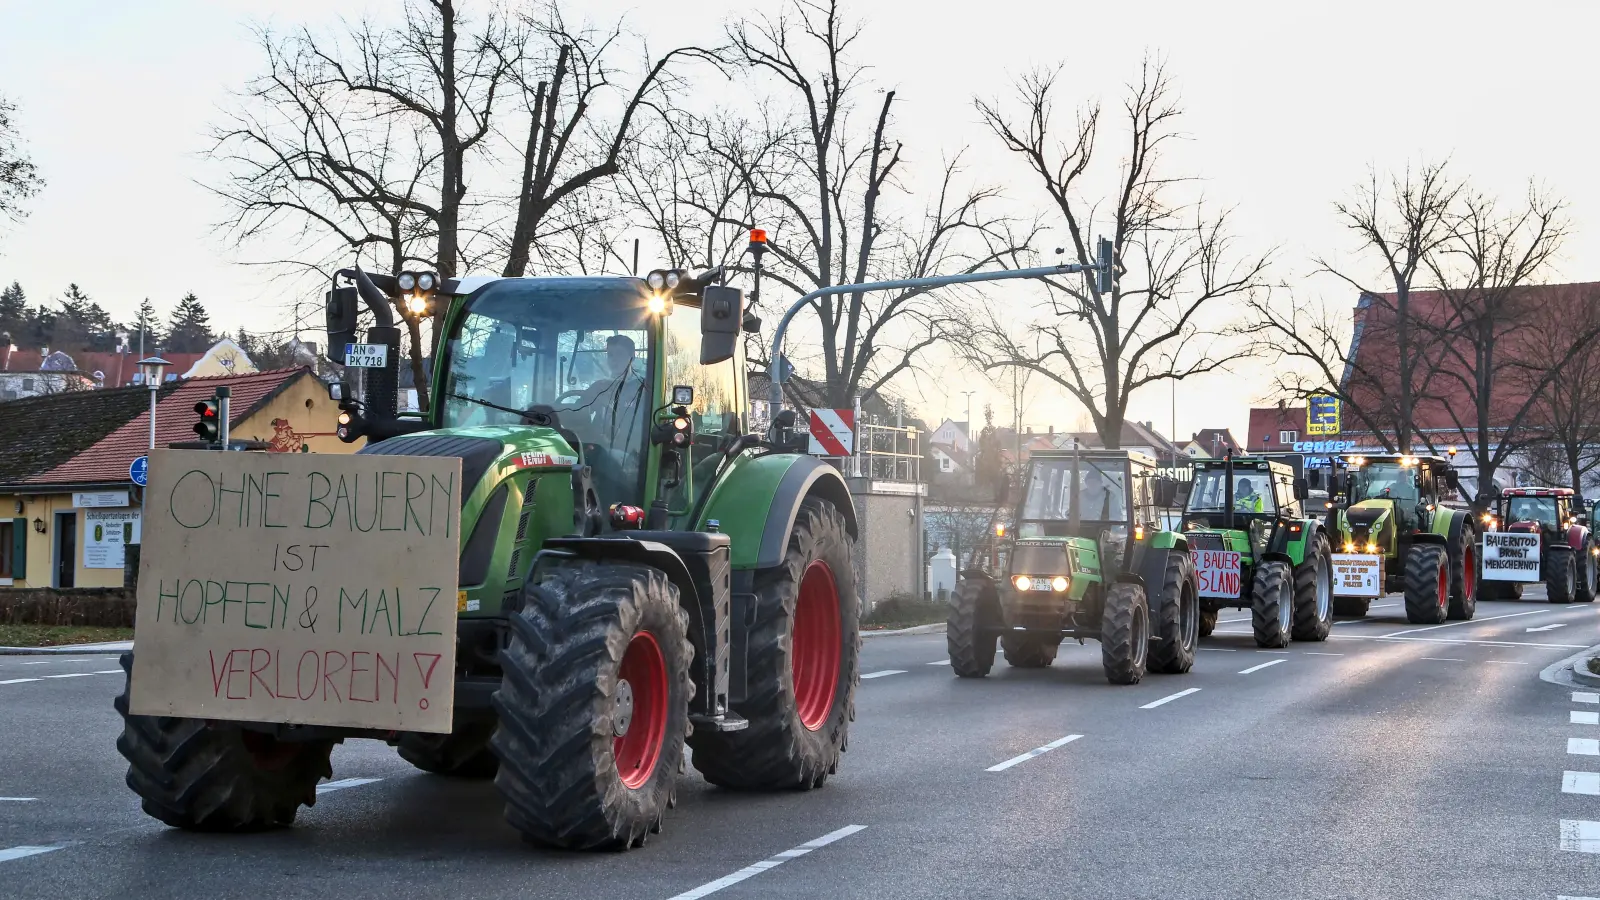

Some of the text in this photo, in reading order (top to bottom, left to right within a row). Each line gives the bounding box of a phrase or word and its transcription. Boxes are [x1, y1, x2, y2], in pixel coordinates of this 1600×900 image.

[353, 345, 366, 355] AN
[350, 356, 382, 366] PK 718
[1293, 440, 1355, 453] center
[521, 451, 547, 466] FENDT
[169, 469, 453, 539] OHNE BAUERN
[131, 511, 140, 519] der
[1486, 535, 1538, 547] BAUERNTOD
[273, 543, 330, 572] IST
[1204, 552, 1240, 570] BAUER
[1211, 572, 1240, 596] LAND
[156, 579, 443, 636] HOPFEN & MALZ
